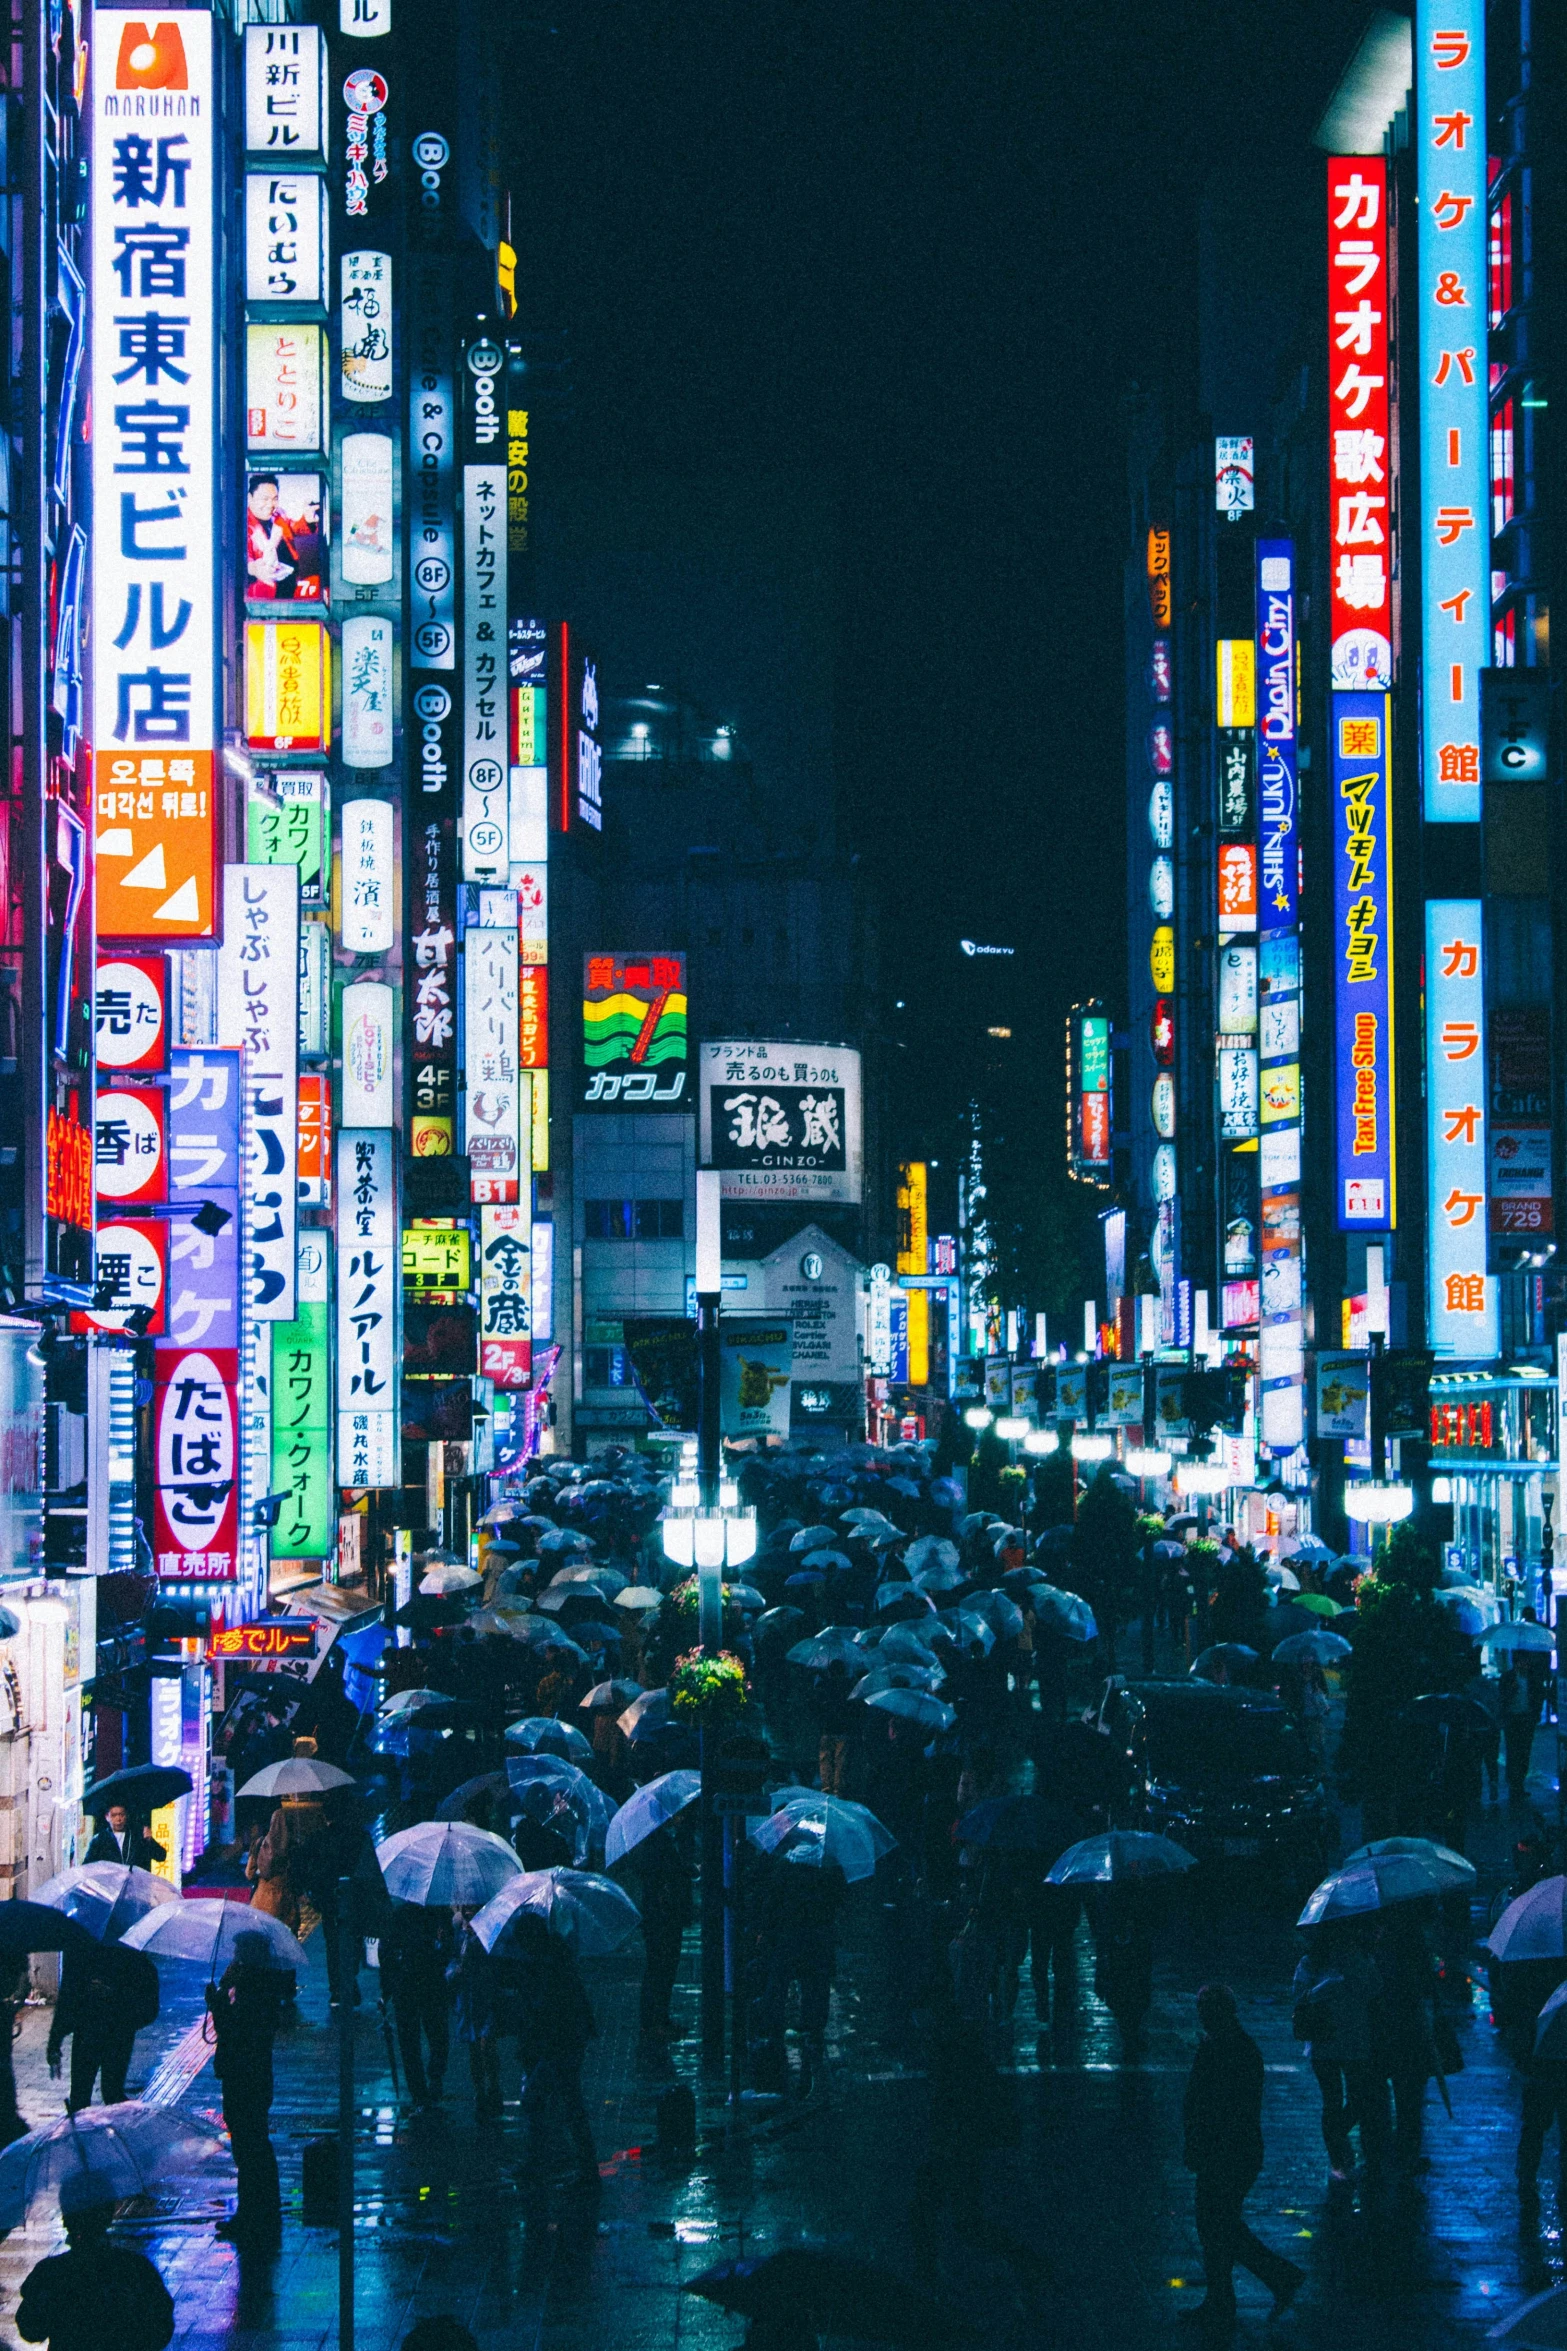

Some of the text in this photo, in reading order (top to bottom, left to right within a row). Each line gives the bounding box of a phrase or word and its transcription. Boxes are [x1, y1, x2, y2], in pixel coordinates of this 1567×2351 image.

[104, 94, 200, 117] MARUHAN
[265, 32, 300, 146] 川新ビル
[346, 113, 369, 216] ミッキーハウス
[267, 180, 299, 295] にいむら
[274, 337, 297, 440] ととりこ
[423, 402, 443, 420] &
[467, 341, 504, 443] Booth
[1333, 173, 1387, 609] カラオケ歌広場
[112, 132, 192, 743] 新宿東宝ビル店
[417, 432, 443, 543] Capsule
[1227, 510, 1243, 522] 8F
[475, 480, 497, 609] ネットカフェ
[297, 580, 316, 597] 7F
[355, 589, 380, 601] 5F
[280, 637, 302, 724] 鳥貴族
[350, 647, 383, 712] 楽天屋
[475, 653, 497, 741] カプセル
[109, 759, 196, 787] 오른쪽
[274, 737, 293, 749] 6F
[414, 684, 452, 792] Booth
[1344, 723, 1375, 754] 薬
[97, 791, 207, 820] 대각선 뒤로!
[1225, 746, 1248, 815] 山内農場
[288, 804, 309, 865] カワノ
[360, 819, 375, 871] 鉄板焼
[1263, 763, 1291, 889] SHINJUKU
[302, 885, 319, 898] 5F
[424, 823, 441, 923] 手作り居酒屋
[1342, 773, 1378, 982] マツモトキヨシ
[239, 876, 270, 1054] しゃぶしゃぶ
[412, 926, 454, 1048] 甘太郎
[481, 935, 515, 1084] バリバリ鶏
[417, 1065, 450, 1086] 4F
[585, 1072, 686, 1101] カワノ
[710, 1046, 768, 1059] ブランド品
[726, 1061, 839, 1083] 売るのも買うのも
[1352, 1012, 1378, 1157] Tax Free Shop
[417, 1088, 450, 1109] 3F
[724, 1093, 841, 1154] 銀蔵
[1442, 940, 1486, 1312] カラオケ館
[171, 1055, 232, 1346] カラオケ
[353, 1141, 378, 1237] 喫茶室
[474, 1182, 507, 1202] B1
[722, 1186, 798, 1196] http://ginzo.jp
[738, 1174, 833, 1185] TEL.03-5366-7800
[1497, 1167, 1545, 1179] EXCHANGE
[1501, 1202, 1541, 1211] BRAND
[1501, 1211, 1541, 1227] 729
[485, 1234, 530, 1335] 金の蔵
[348, 1250, 387, 1396] ルノアール
[171, 1378, 223, 1525] たばこ
[287, 1350, 312, 1547] カワノ・クォーク
[352, 1414, 369, 1486] 磯丸水産
[158, 1551, 231, 1577] 直売所
